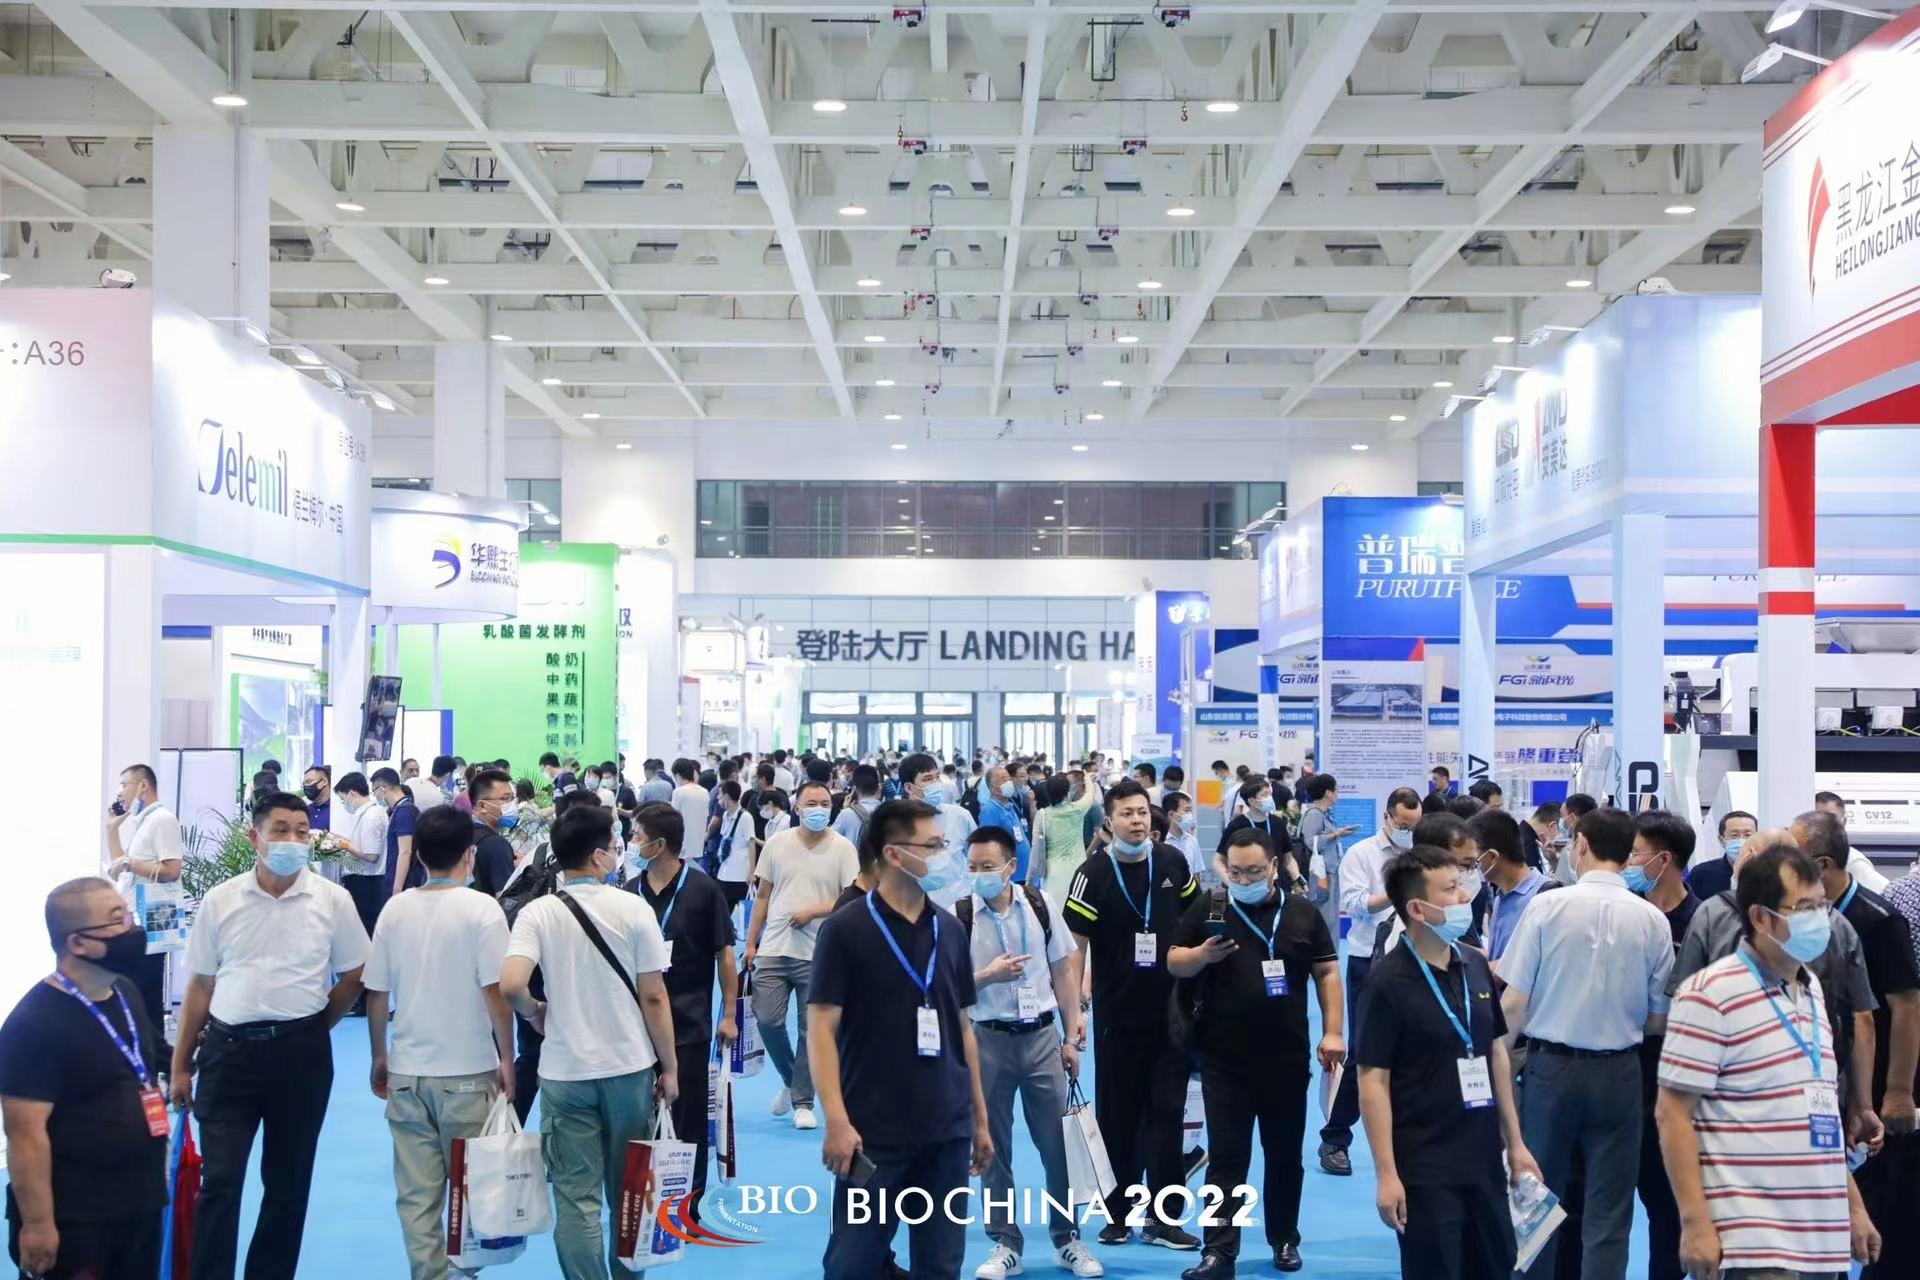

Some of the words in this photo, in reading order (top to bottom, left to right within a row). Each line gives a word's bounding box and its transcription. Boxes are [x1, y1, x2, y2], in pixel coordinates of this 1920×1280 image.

[0, 340, 85, 366] :A36
[483, 624, 586, 639] 乳酸菌发酵剂
[796, 629, 928, 662] 登陆大厅
[941, 631, 1087, 661] LANDING
[546, 652, 578, 666] 酸奶
[546, 672, 578, 686] 中药
[546, 692, 578, 706] 果蔬
